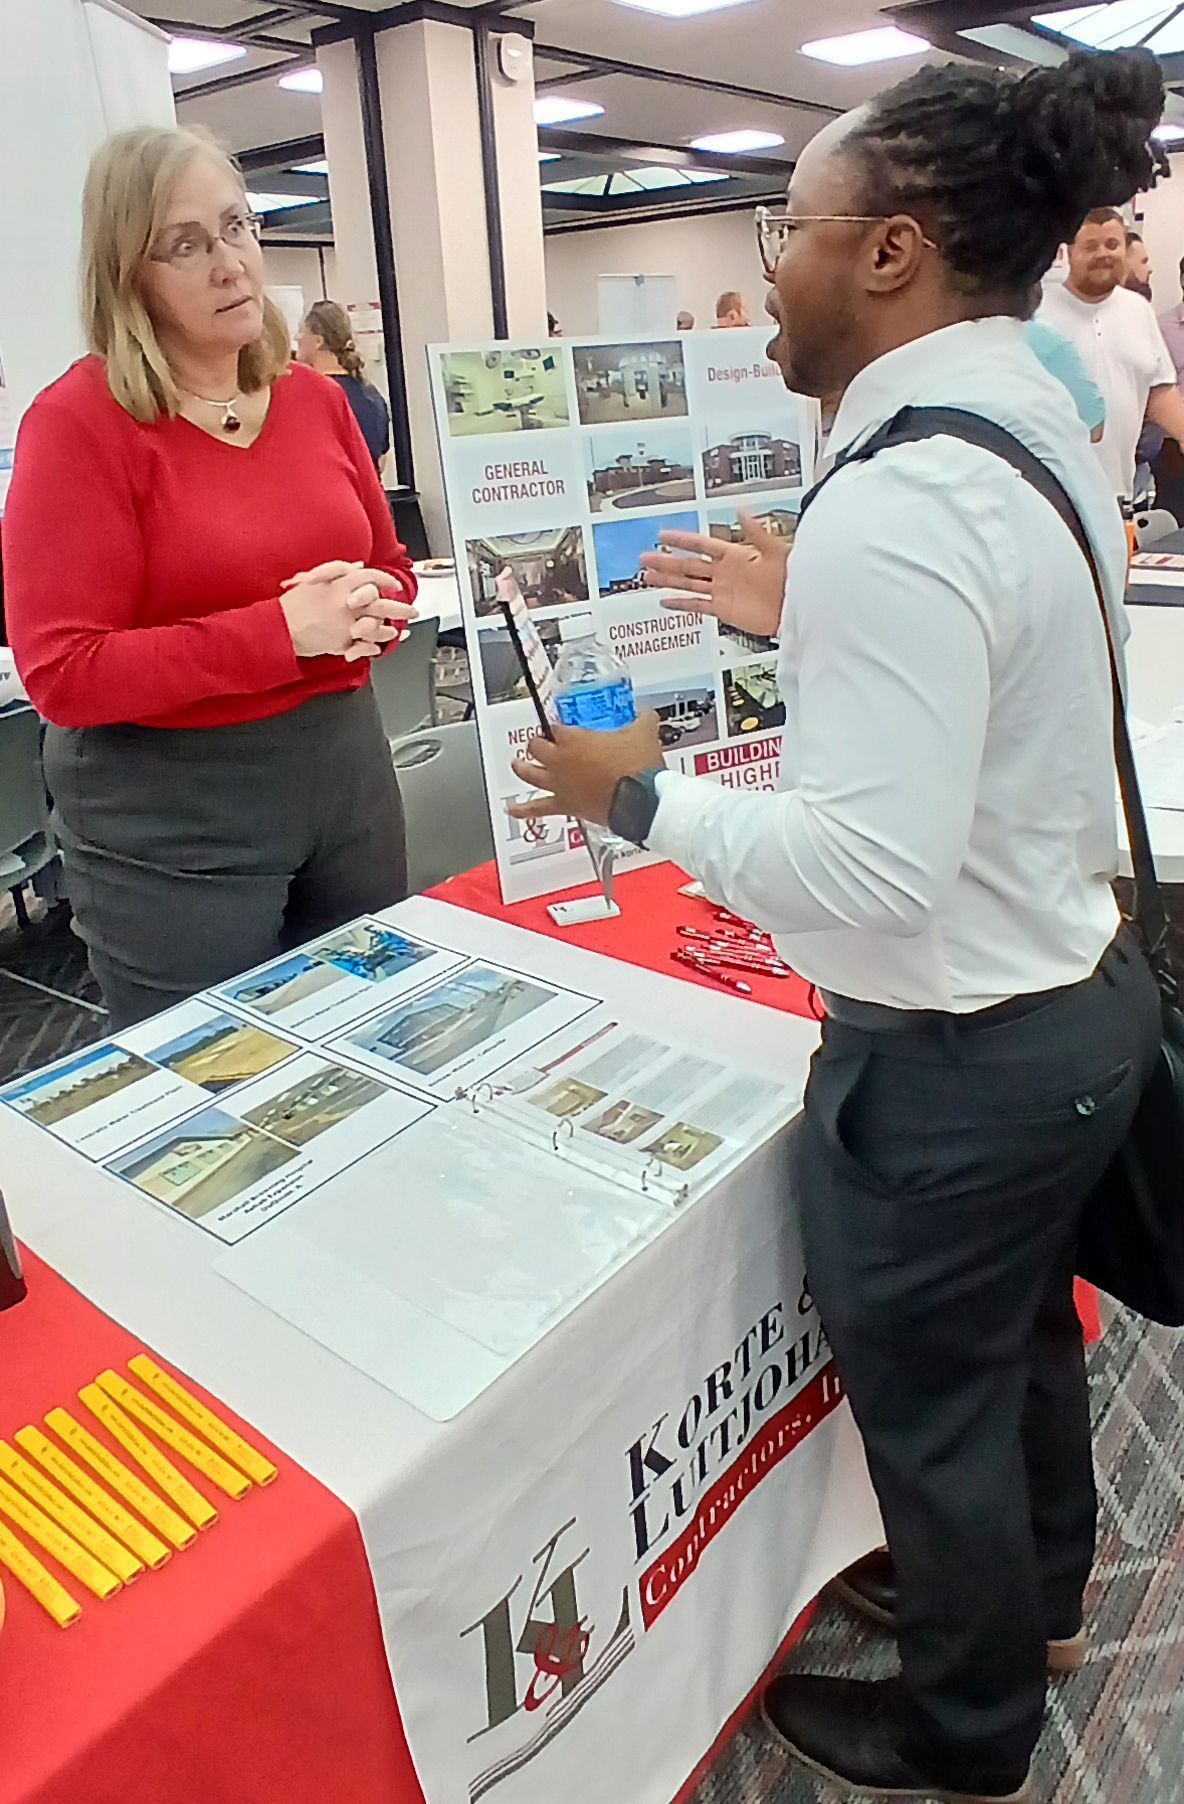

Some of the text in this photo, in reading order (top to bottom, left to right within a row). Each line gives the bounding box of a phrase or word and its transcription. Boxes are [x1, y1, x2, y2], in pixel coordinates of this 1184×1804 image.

[484, 460, 549, 480] GENERAL
[472, 480, 565, 504] CONTRACTOR
[609, 611, 703, 640] CONSTRUCTION
[615, 631, 701, 660] MANAGEMENT
[625, 1303, 784, 1508] KORTE
